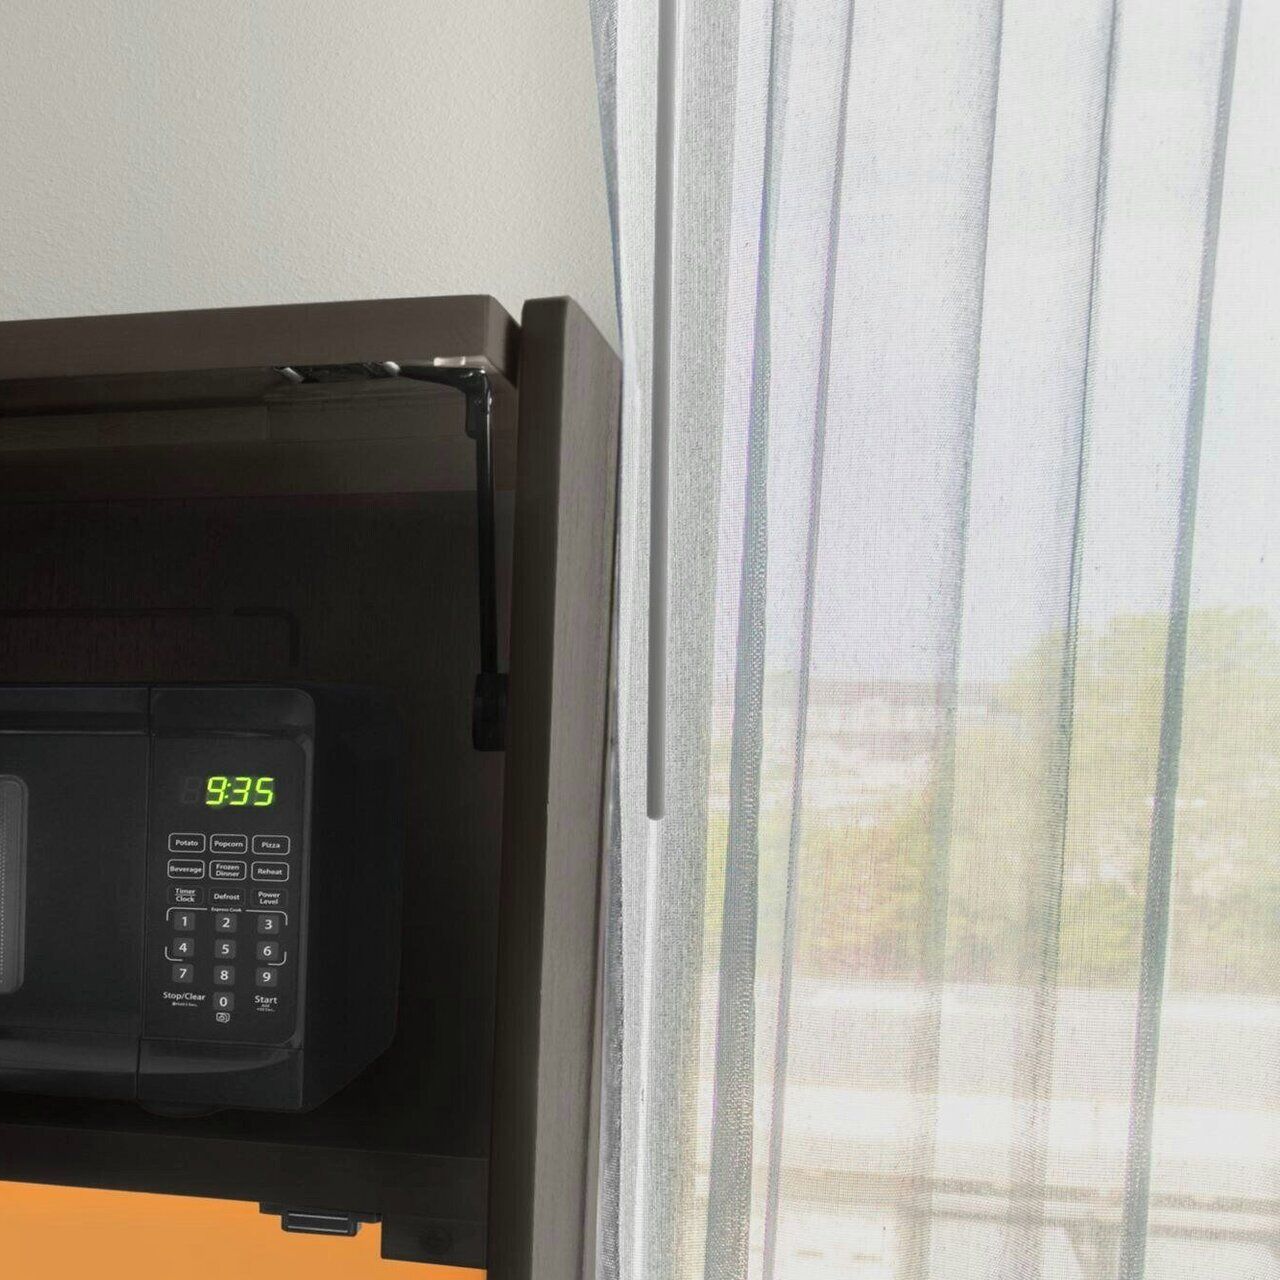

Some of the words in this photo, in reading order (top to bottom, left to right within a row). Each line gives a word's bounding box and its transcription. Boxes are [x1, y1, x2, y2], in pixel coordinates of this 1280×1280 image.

[205, 776, 274, 806] 9:35
[175, 839, 199, 847] Potato
[214, 840, 244, 849] Popcorn
[261, 841, 281, 849] Pizza
[169, 866, 202, 874] Beverage
[215, 863, 240, 871] Frozen
[215, 870, 240, 878] Dinner
[257, 868, 283, 876] Reheat
[175, 887, 196, 895] Timer
[257, 890, 280, 898] Power
[175, 895, 196, 903] Clock
[213, 893, 240, 901] Defrost
[181, 916, 188, 927] 1
[222, 917, 231, 928] 2
[264, 919, 273, 930] 3
[179, 942, 188, 953] 4
[221, 944, 230, 954] 5
[263, 945, 272, 957] 6
[179, 968, 187, 979] 7
[220, 970, 229, 981] 8
[262, 971, 272, 982] 9
[163, 991, 206, 1000] Stop/Clear
[254, 995, 278, 1004] Start
[219, 996, 228, 1007] 0
